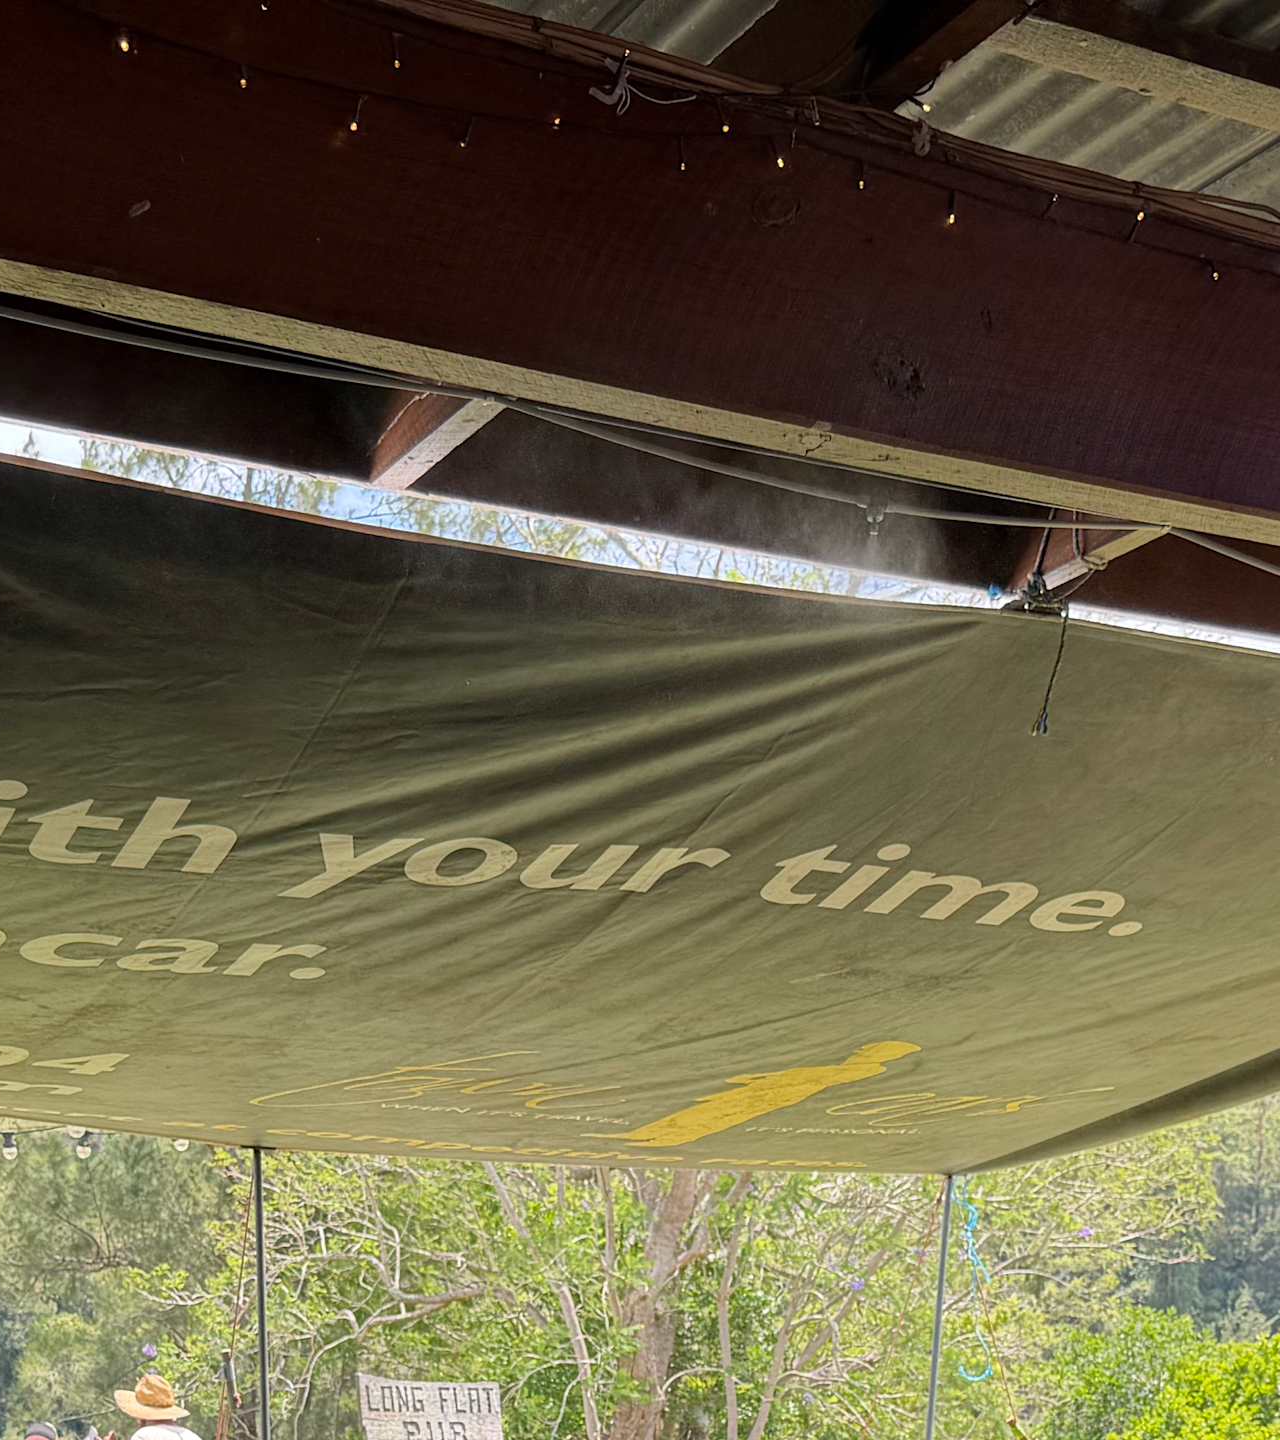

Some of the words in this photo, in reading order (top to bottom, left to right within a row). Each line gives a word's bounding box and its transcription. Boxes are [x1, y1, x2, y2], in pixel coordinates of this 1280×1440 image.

[278, 833, 731, 898] your
[760, 843, 1143, 937] time.
[365, 1384, 425, 1413] LONG
[438, 1387, 494, 1413] FLAT
